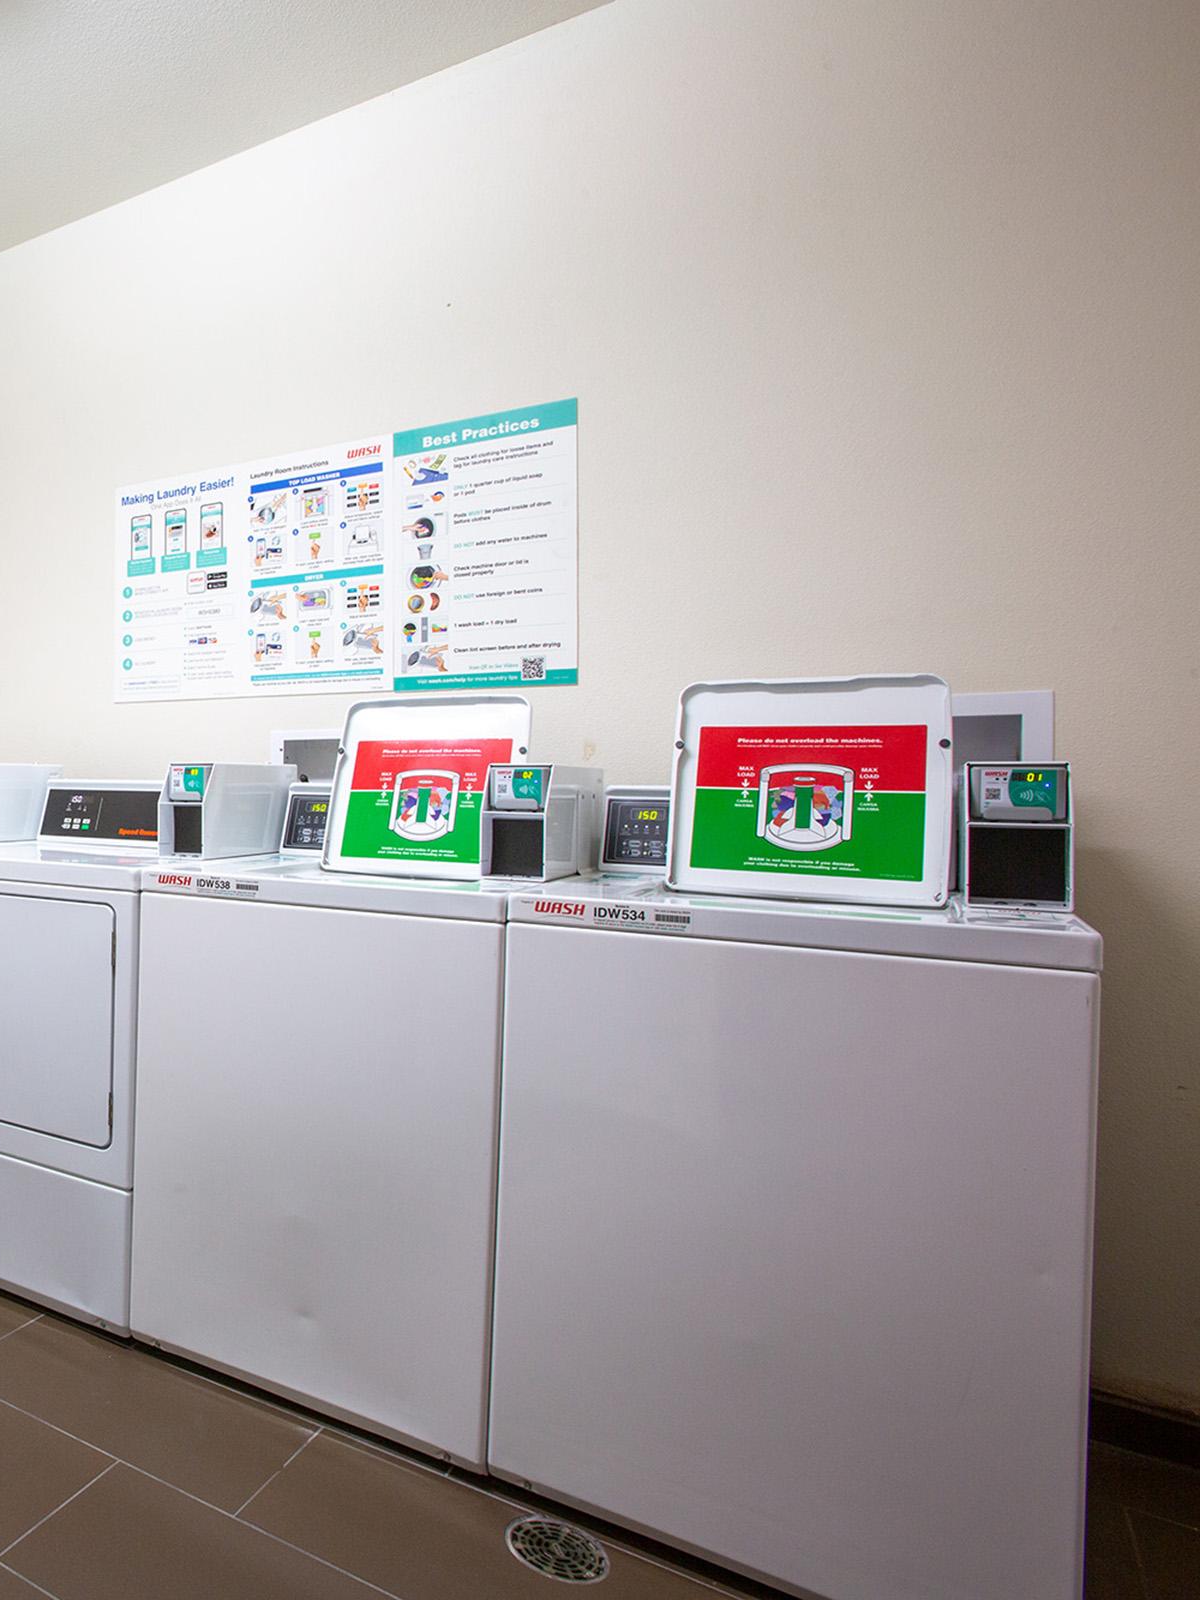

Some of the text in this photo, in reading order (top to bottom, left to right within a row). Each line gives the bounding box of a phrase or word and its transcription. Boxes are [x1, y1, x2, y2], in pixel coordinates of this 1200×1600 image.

[422, 417, 540, 448] Best Practices
[348, 445, 381, 458] WASH
[472, 457, 491, 465] laundry
[506, 450, 538, 459] instructions
[250, 471, 273, 479] Laundry
[293, 461, 328, 471] Instructions
[301, 476, 316, 484] LOAD
[317, 472, 340, 481] WASHER
[474, 480, 492, 488] quarter
[122, 477, 234, 506] Making Laundry Easier!
[1027, 772, 1043, 782] 01
[638, 811, 658, 820] 150
[158, 875, 230, 889] WASH IDW538
[534, 900, 645, 921] WASH IDW534
